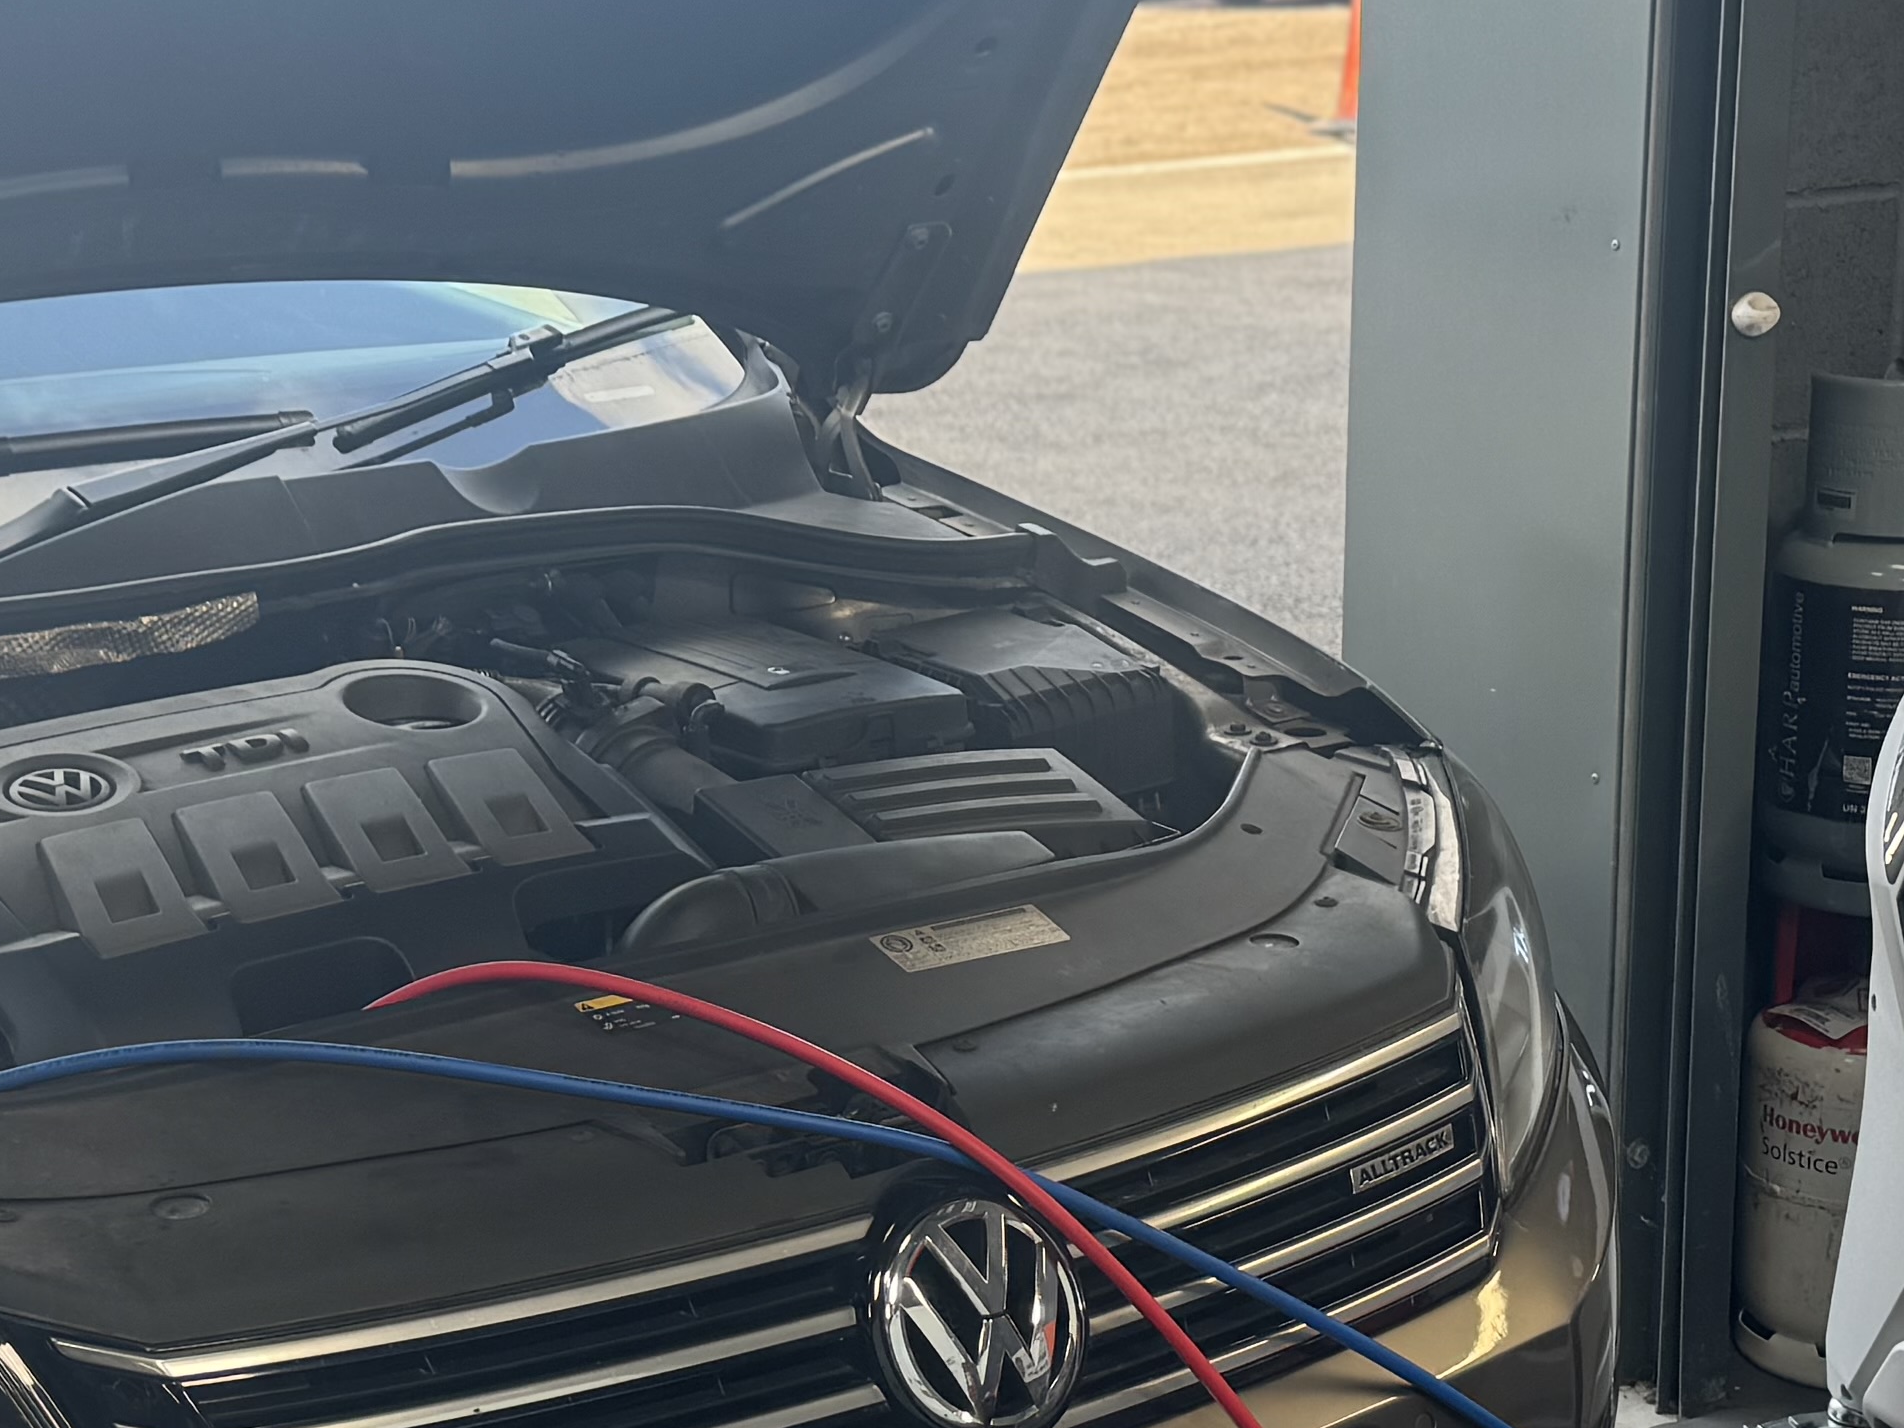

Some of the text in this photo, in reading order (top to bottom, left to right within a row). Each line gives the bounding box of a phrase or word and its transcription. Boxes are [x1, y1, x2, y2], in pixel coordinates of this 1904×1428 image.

[1788, 591, 1806, 693] automotive
[179, 728, 310, 772] TDI
[1358, 1129, 1449, 1187] ALLTRACK
